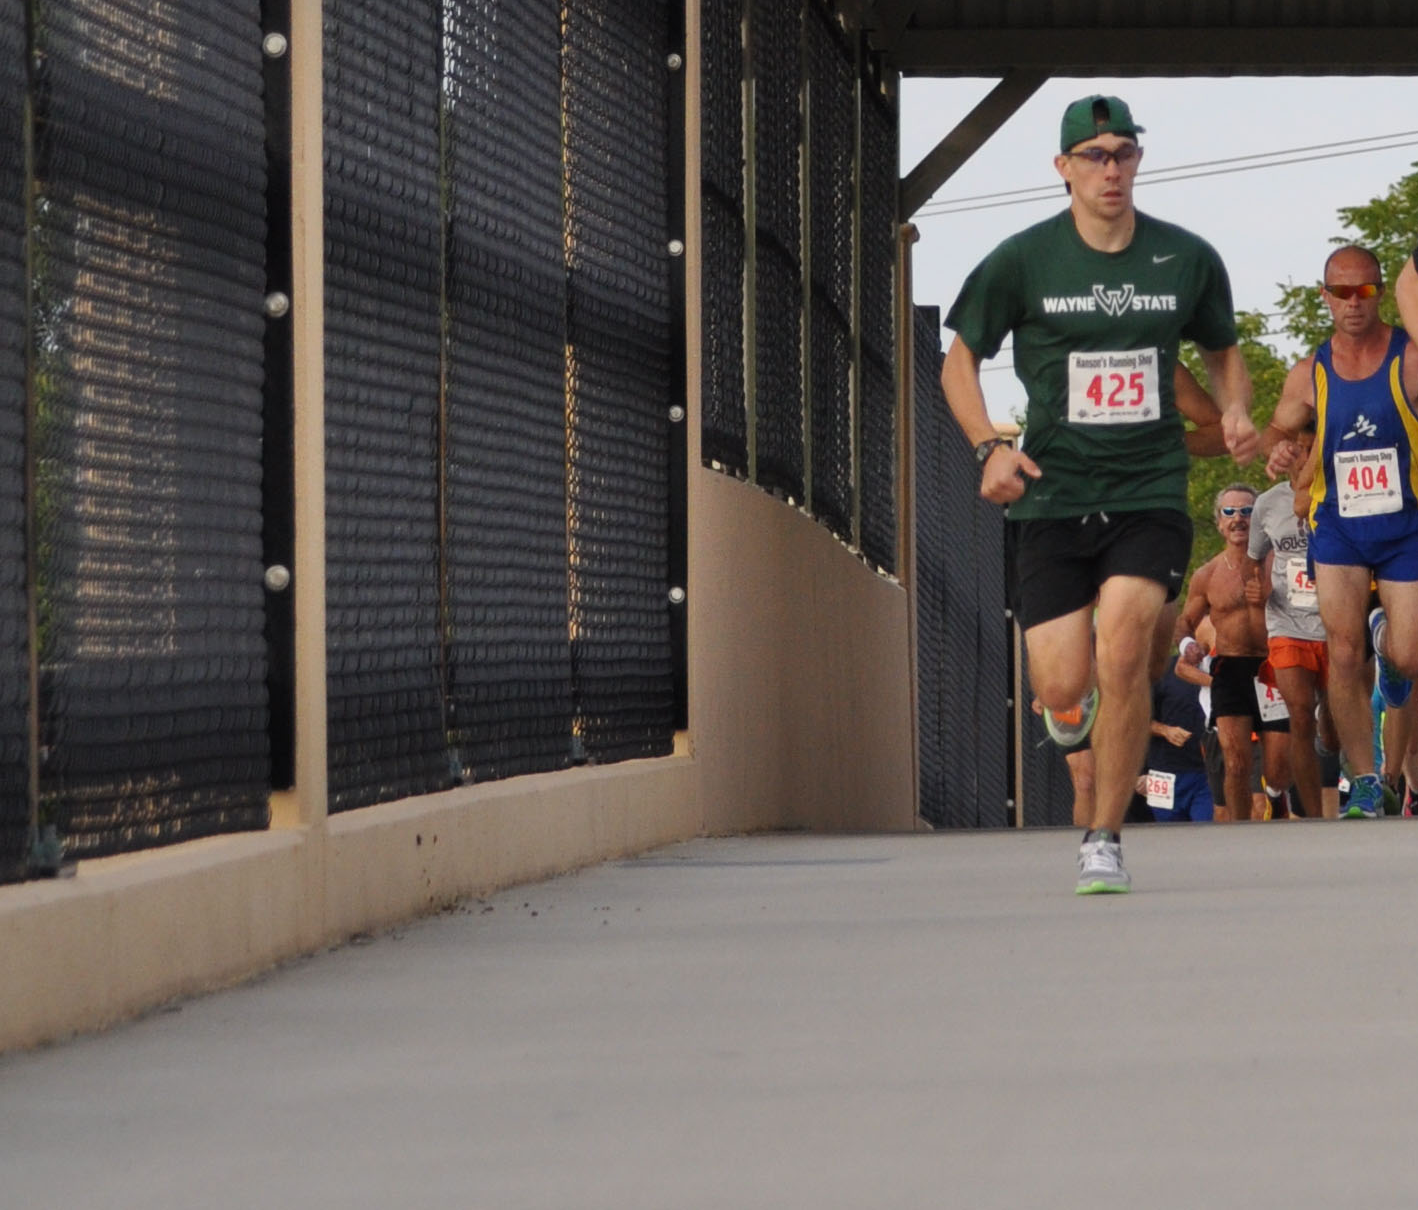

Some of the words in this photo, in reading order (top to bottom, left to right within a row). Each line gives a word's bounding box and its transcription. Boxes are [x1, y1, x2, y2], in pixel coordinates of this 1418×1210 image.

[1043, 296, 1097, 313] WAYNE
[1132, 295, 1177, 311] STATE
[1108, 355, 1137, 369] Running
[1086, 371, 1145, 407] 425
[1348, 465, 1388, 491] 404
[1148, 778, 1169, 795] 269
